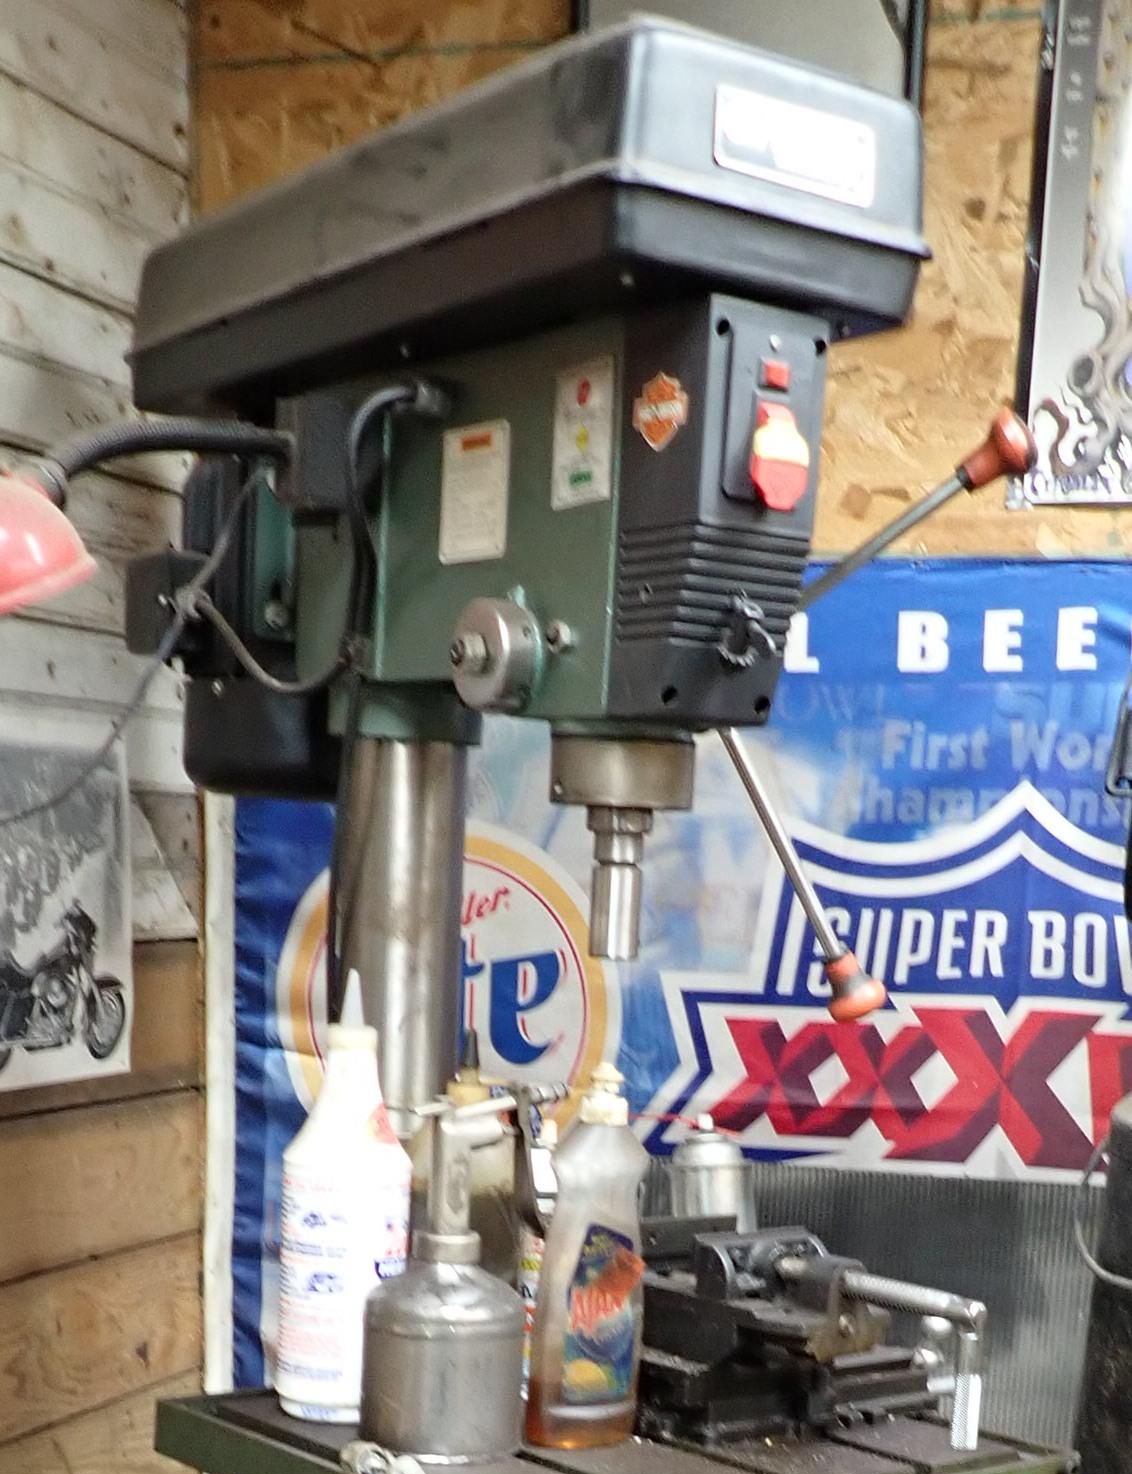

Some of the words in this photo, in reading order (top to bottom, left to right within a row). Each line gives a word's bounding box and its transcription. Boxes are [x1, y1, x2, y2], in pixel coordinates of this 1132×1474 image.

[898, 606, 1099, 674] BEE
[880, 718, 990, 771] First
[1010, 718, 1113, 771] Wor
[807, 906, 1009, 998] SUPER
